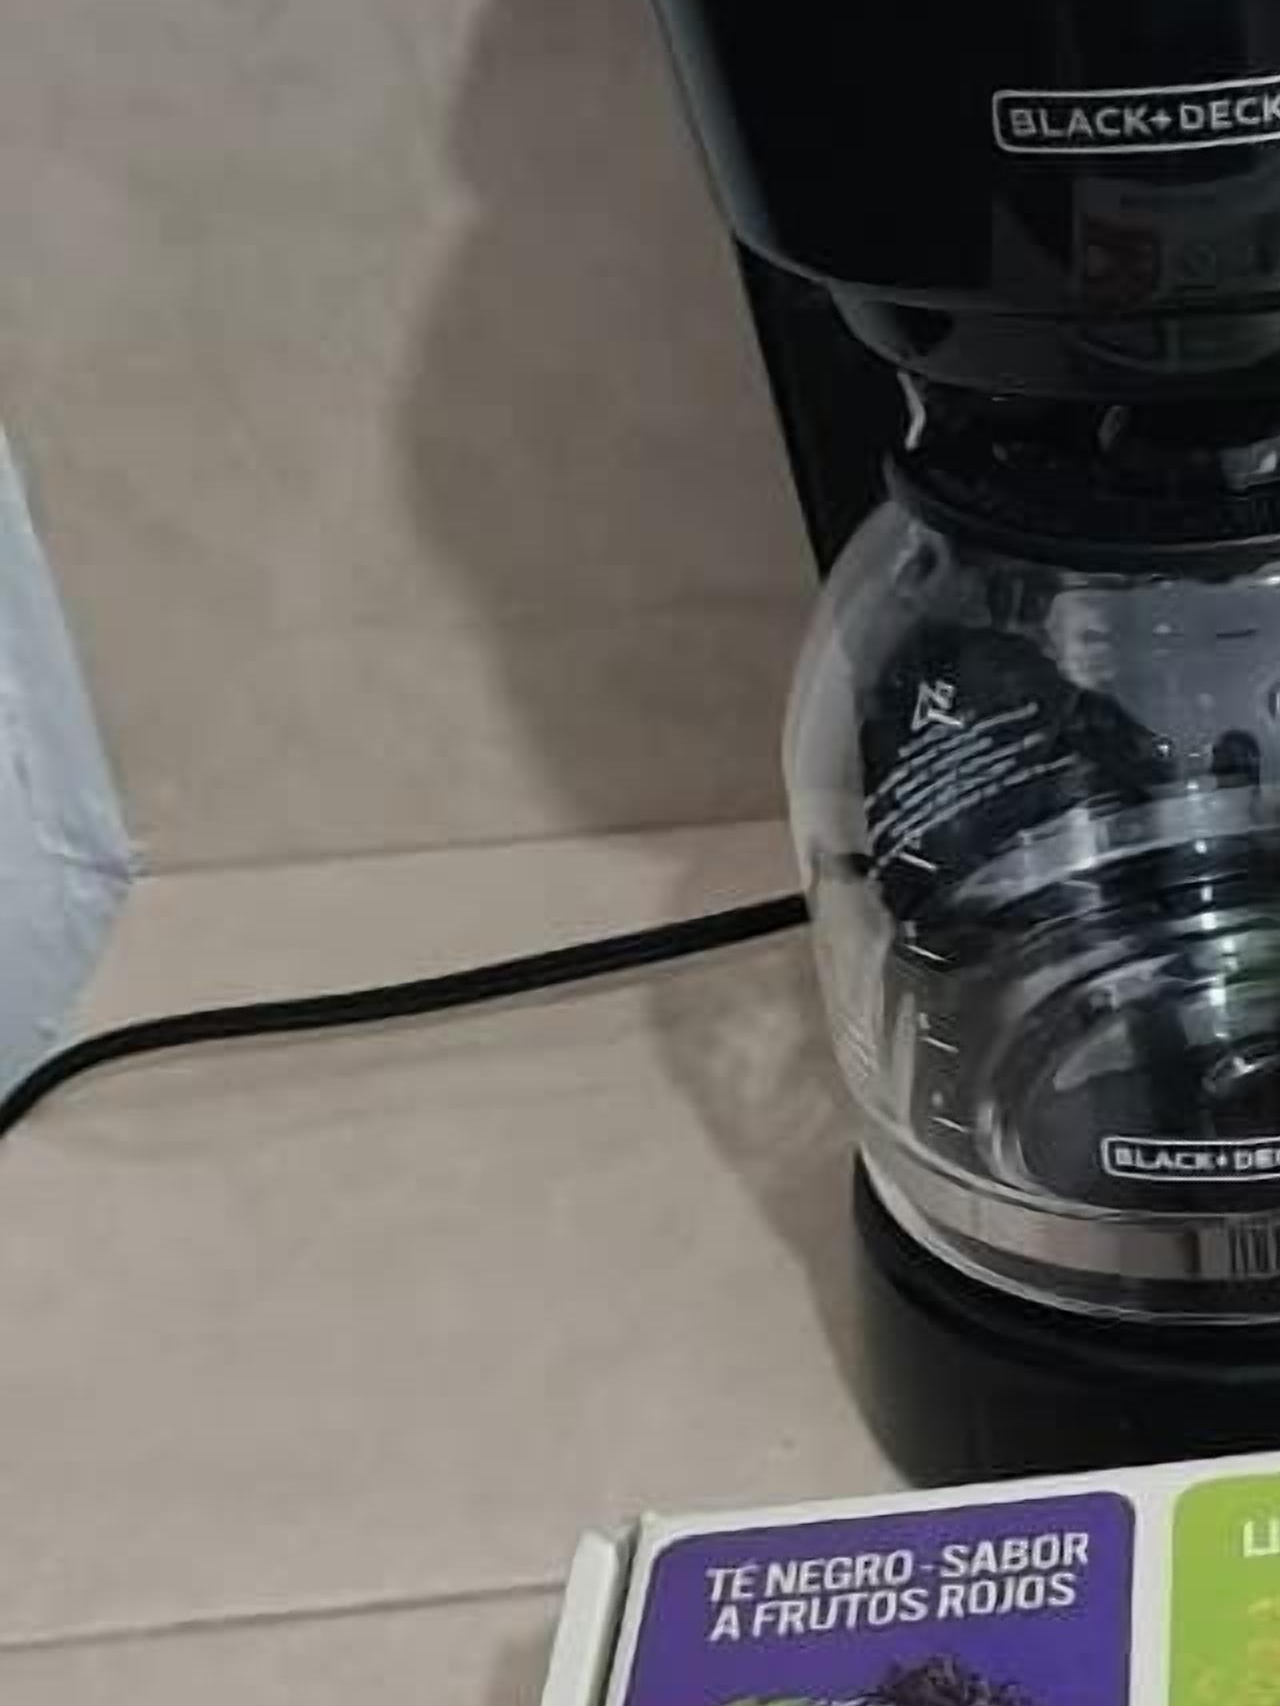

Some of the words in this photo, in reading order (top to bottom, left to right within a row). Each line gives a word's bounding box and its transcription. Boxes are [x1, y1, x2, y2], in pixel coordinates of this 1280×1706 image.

[764, 1548, 914, 1600] NEGRO
[940, 1531, 1090, 1579] SABOR
[708, 1605, 742, 1643] A
[751, 1586, 929, 1638] FRUTOS
[938, 1572, 1077, 1621] ROJOS
